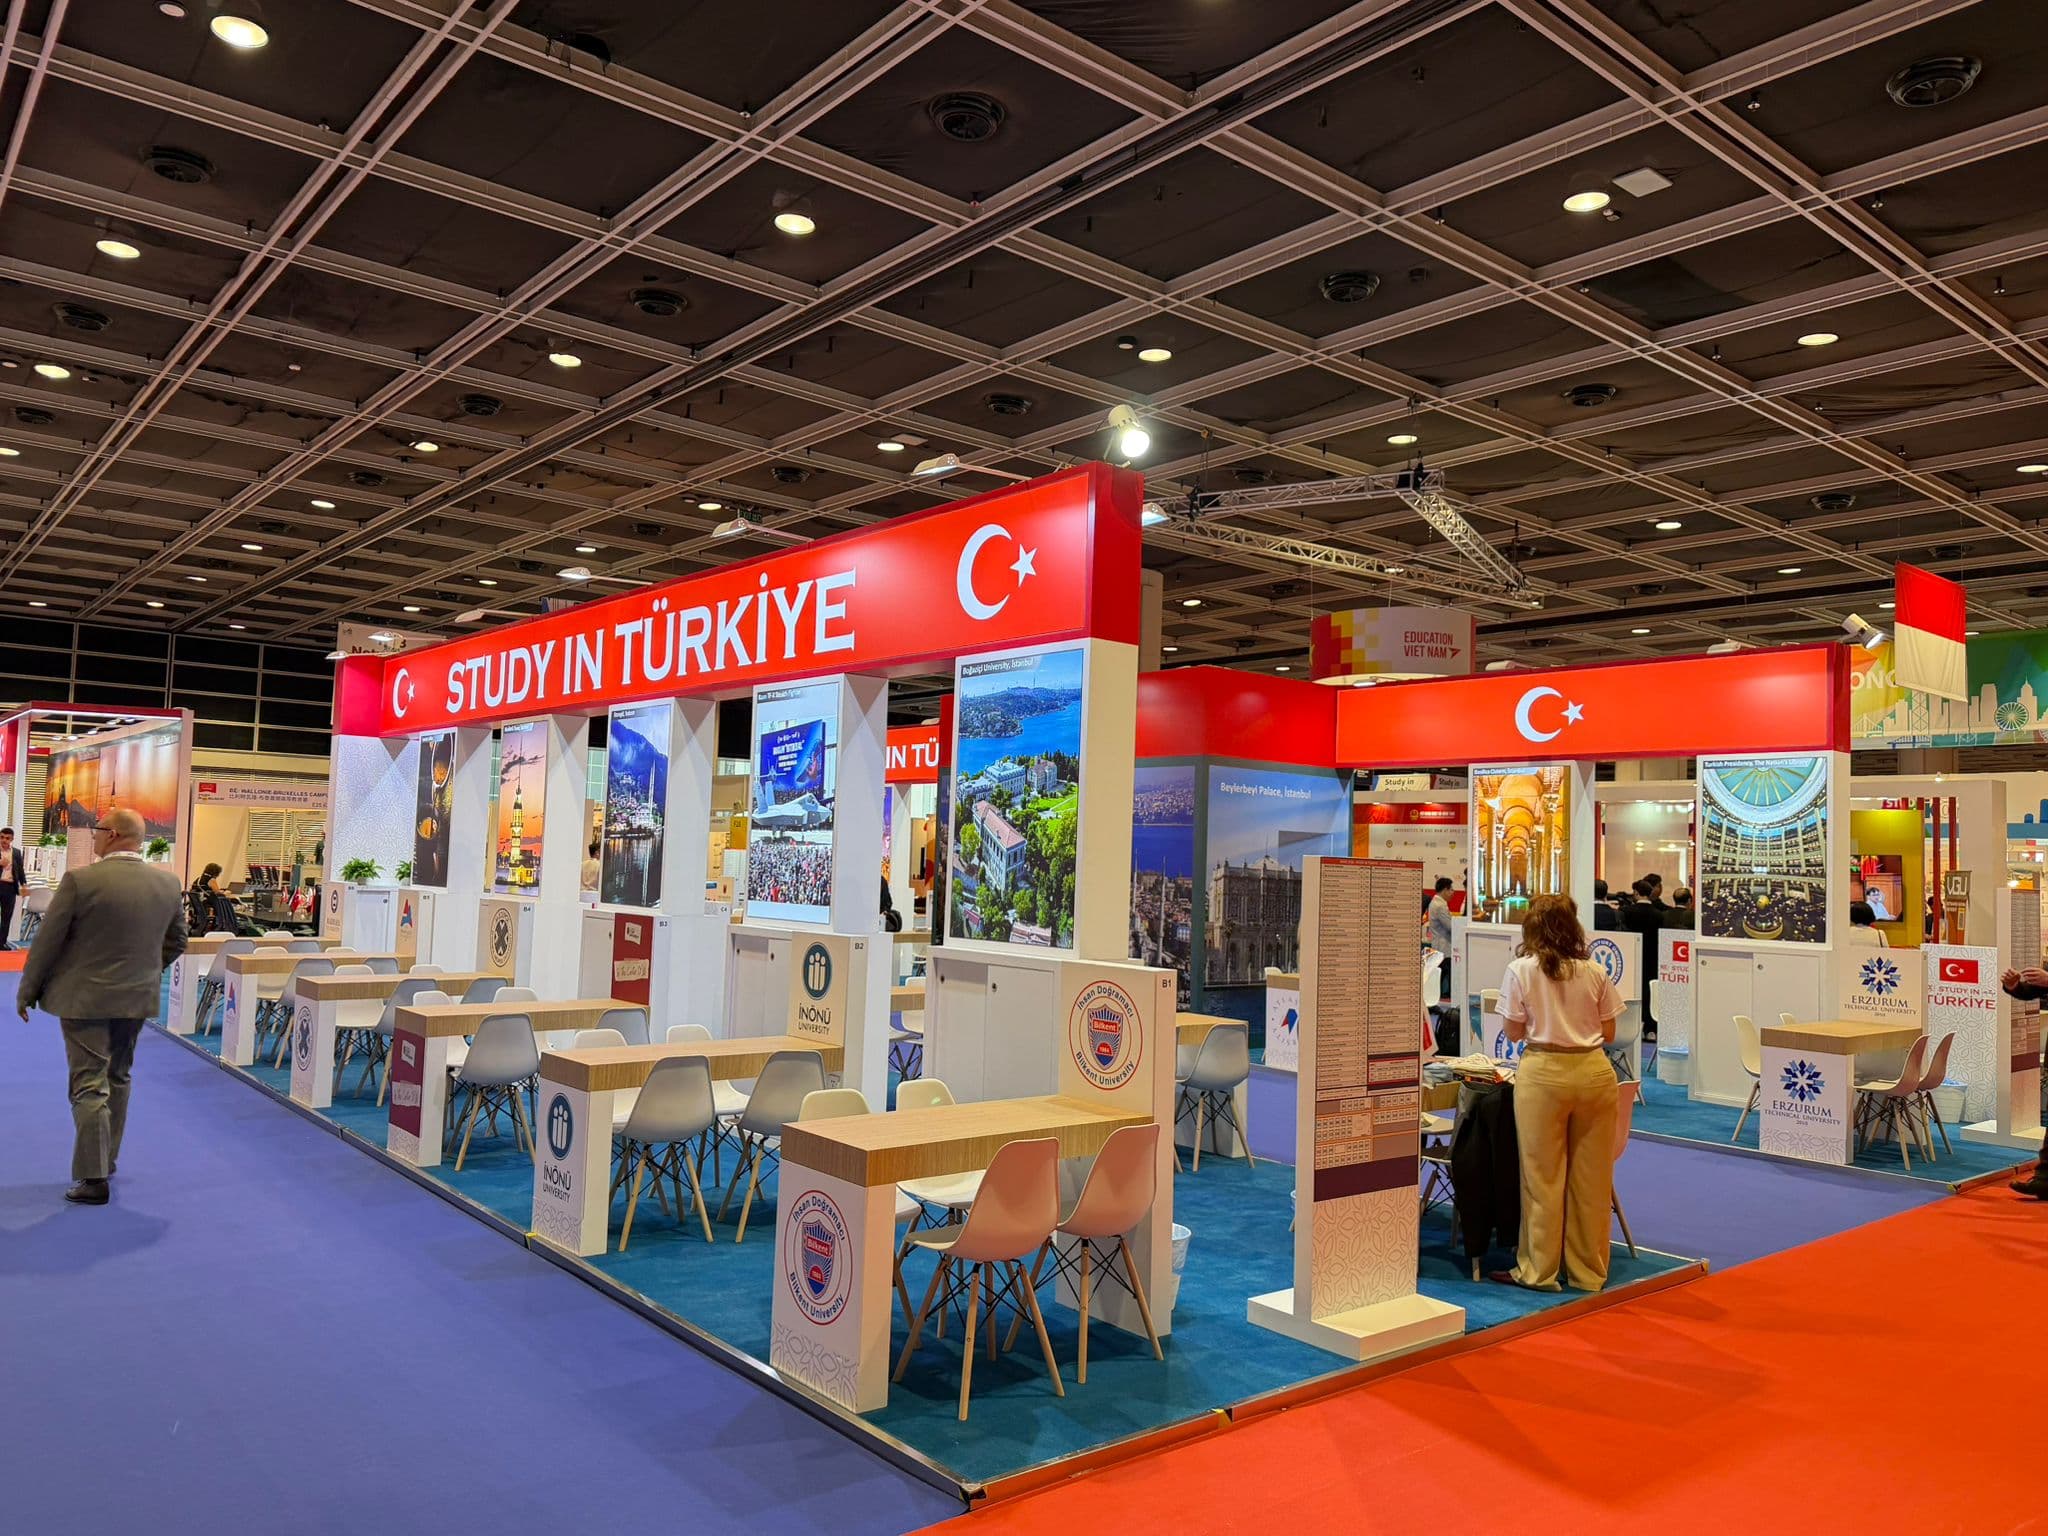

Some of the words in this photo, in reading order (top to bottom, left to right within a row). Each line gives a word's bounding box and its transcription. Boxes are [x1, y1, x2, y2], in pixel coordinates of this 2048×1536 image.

[446, 639, 556, 714] STUDY
[562, 629, 605, 695] IN
[615, 567, 857, 685] TÜRKİYE
[1404, 631, 1453, 645] EDUCATION
[1404, 645, 1425, 657] VIET
[1427, 646, 1447, 658] NAM
[885, 745, 907, 769] IN
[1220, 782, 1258, 796] Beylerbeyi
[1259, 786, 1283, 798] Palace,
[1385, 778, 1405, 787] Study
[1439, 777, 1453, 787] Study
[1946, 876, 1968, 895] VGU
[854, 942, 864, 950] B2
[1162, 979, 1172, 988] B1
[1939, 985, 1968, 994] STUDY
[1843, 1003, 1878, 1012] TECHNICAL
[1880, 1006, 1917, 1015] UNIVERSITY
[1851, 994, 1909, 1008] ERZURUM
[1927, 992, 1996, 1010] TÜRKİYE
[799, 1002, 832, 1025] İNÖNÜ
[798, 1021, 831, 1036] UNIVERSITY
[1093, 1020, 1117, 1032] Bilkent
[1075, 1051, 1098, 1082] Bilkent
[1099, 1060, 1135, 1085] University
[1764, 1108, 1800, 1119] TECHNICAL
[1802, 1114, 1841, 1126] UNIVERSITY
[1772, 1100, 1832, 1118] ERZURUM
[543, 1161, 572, 1191] İNÖNÜ
[543, 1183, 571, 1203] UNIVERSITY
[807, 1238, 830, 1255] Bilkent
[789, 1271, 810, 1311] Bilkent
[810, 1294, 845, 1318] University
